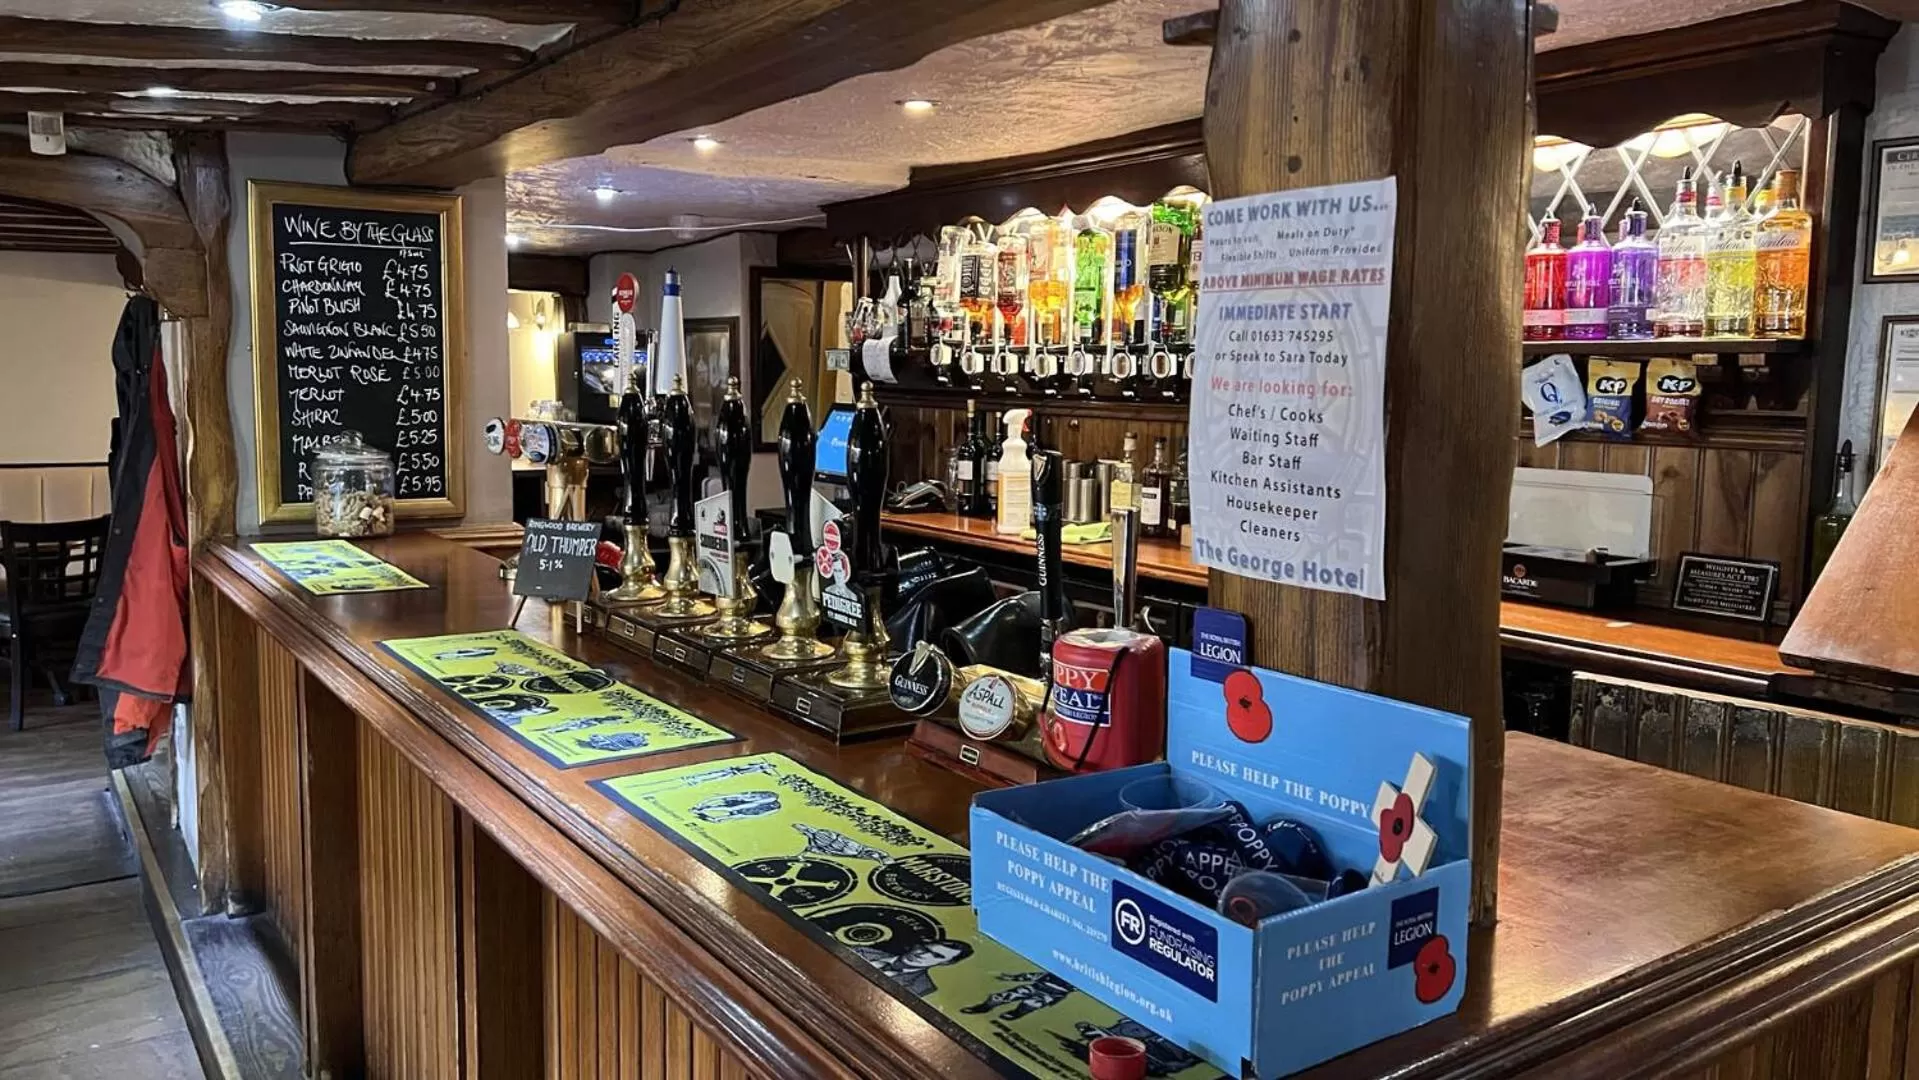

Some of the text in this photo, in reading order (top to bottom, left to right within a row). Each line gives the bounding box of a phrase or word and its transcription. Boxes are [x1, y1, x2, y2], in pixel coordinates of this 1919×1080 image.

[1207, 208, 1243, 227] COME
[1248, 201, 1291, 222] WORK
[1296, 198, 1342, 217] WITH
[285, 214, 434, 246] WINE BY THE GLASS
[1277, 229, 1304, 240] Meals
[1307, 230, 1320, 239] on
[1221, 250, 1277, 263] Flexible Shifts
[1288, 243, 1382, 258] Uniform Provided
[318, 256, 362, 276] GRIGIO
[282, 277, 366, 297] CHARDONNAY
[1203, 267, 1386, 290] ABOVE MINIMUM WAGE RATES
[289, 296, 320, 314] PINOT
[323, 297, 361, 316] BLUSH
[1219, 302, 1353, 321] IMMEDIATE START
[283, 319, 349, 337] SAUVIGNON
[353, 322, 397, 338] BLANC
[1228, 330, 1334, 343] Call 01633 745295
[1215, 350, 1348, 368] or Speak to Sara Today
[288, 364, 344, 383] MERLOT
[1211, 376, 1353, 400] We are looking for:
[1599, 379, 1627, 394] KP
[1662, 378, 1692, 393] KP
[291, 409, 343, 429] SHIRAZ
[1228, 403, 1324, 424] Chef's / Cooks
[1230, 427, 1320, 448] Waiting Staff
[1242, 451, 1302, 470] Bar Staff
[1210, 470, 1342, 499] Kitchen Assistants
[1226, 495, 1319, 521] Housekeeper
[527, 519, 596, 532] RINGWOOD BREWERY
[1240, 520, 1300, 542] Cleaners
[526, 532, 598, 557] OLD THUMPER
[1037, 532, 1047, 587] GUINNESS
[1196, 538, 1364, 590] The George Hotel
[822, 592, 863, 619] PEDIGREE
[1200, 642, 1241, 664] LEGION
[894, 674, 929, 696] GUINNESS
[1055, 664, 1099, 690] PPY
[966, 684, 1005, 709] ASPALL
[1191, 750, 1371, 818] PLEASE HELP THE POPPY
[996, 830, 1110, 893] PLEASE HELP THE
[1007, 859, 1097, 914] POPPY APPEAL
[1121, 910, 1140, 935] FR
[1394, 920, 1433, 946] LEGION
[1149, 925, 1215, 968] FUNDRAISING
[1287, 922, 1376, 960] PLEASE HELP
[1149, 937, 1215, 982] REGULATOR
[1319, 952, 1345, 971] THE
[1281, 962, 1376, 1006] POPPY APPEAL
